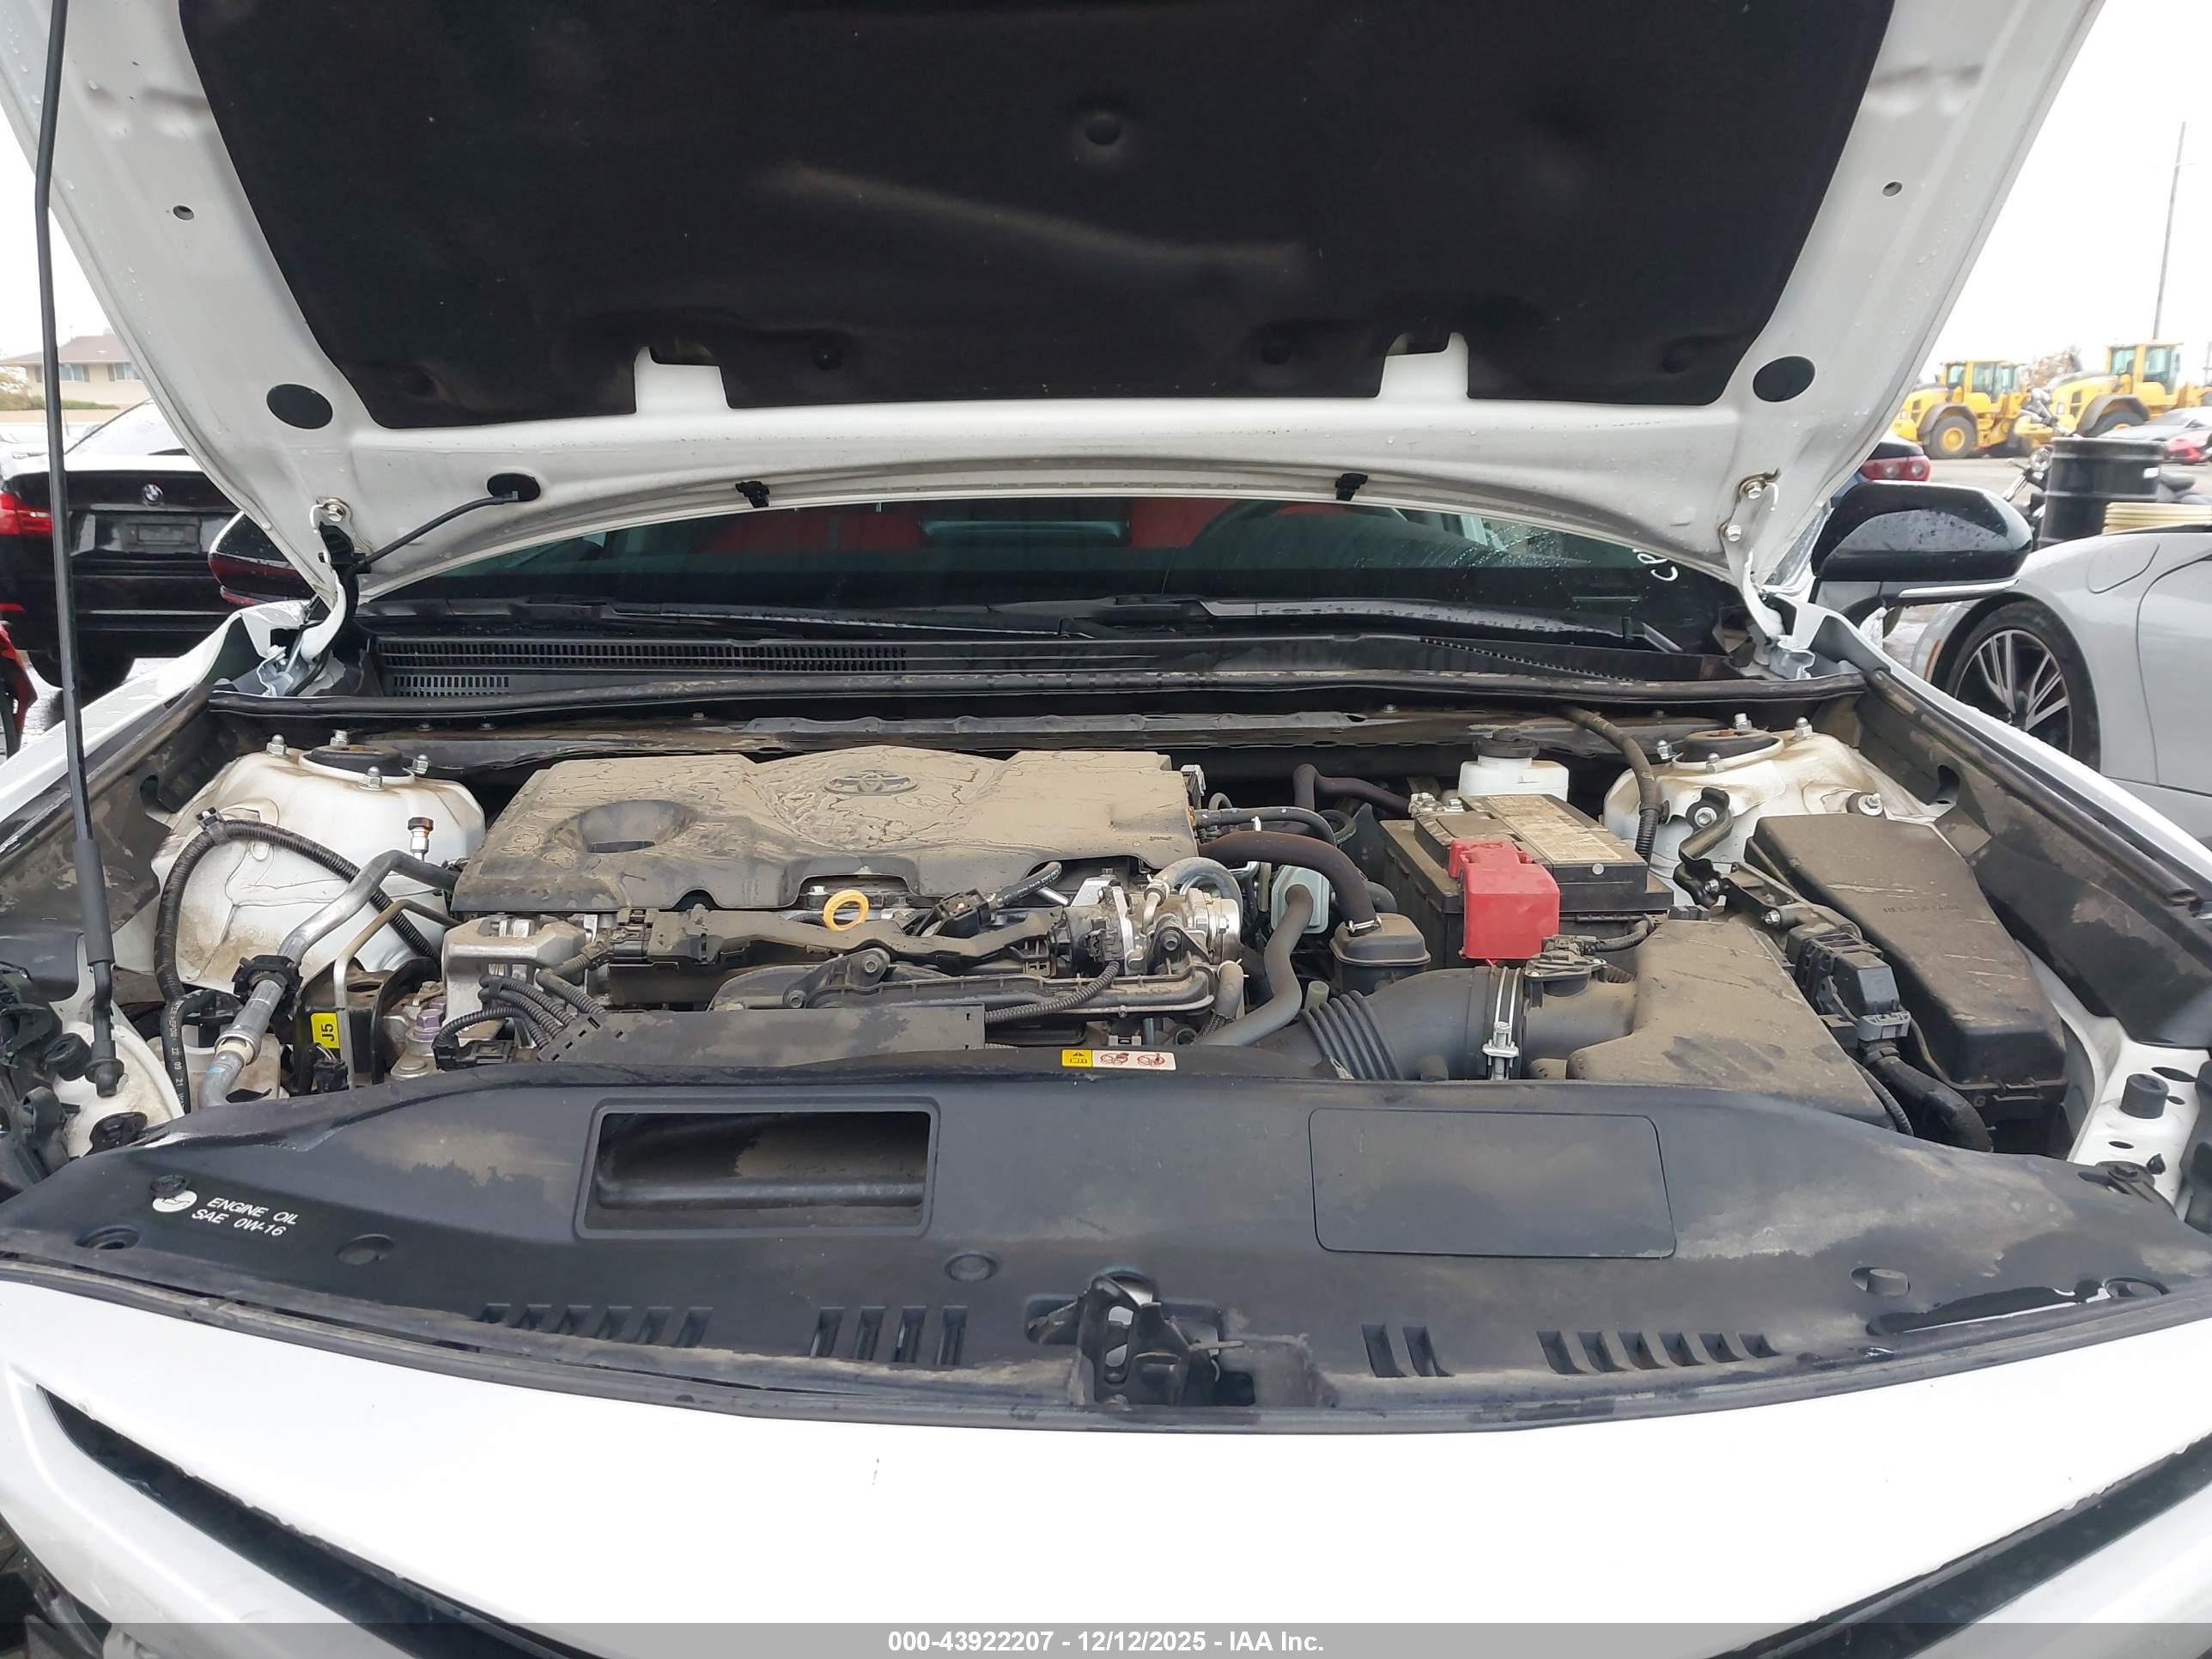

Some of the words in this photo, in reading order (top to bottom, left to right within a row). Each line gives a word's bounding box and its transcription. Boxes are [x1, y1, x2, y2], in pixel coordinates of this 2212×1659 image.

[320, 1024, 335, 1042] J5
[175, 1078, 184, 1086] 21
[207, 1197, 270, 1218] ENGINE
[272, 1211, 299, 1224] OIL
[191, 1208, 229, 1224] SAE
[234, 1218, 287, 1237] 0W-16
